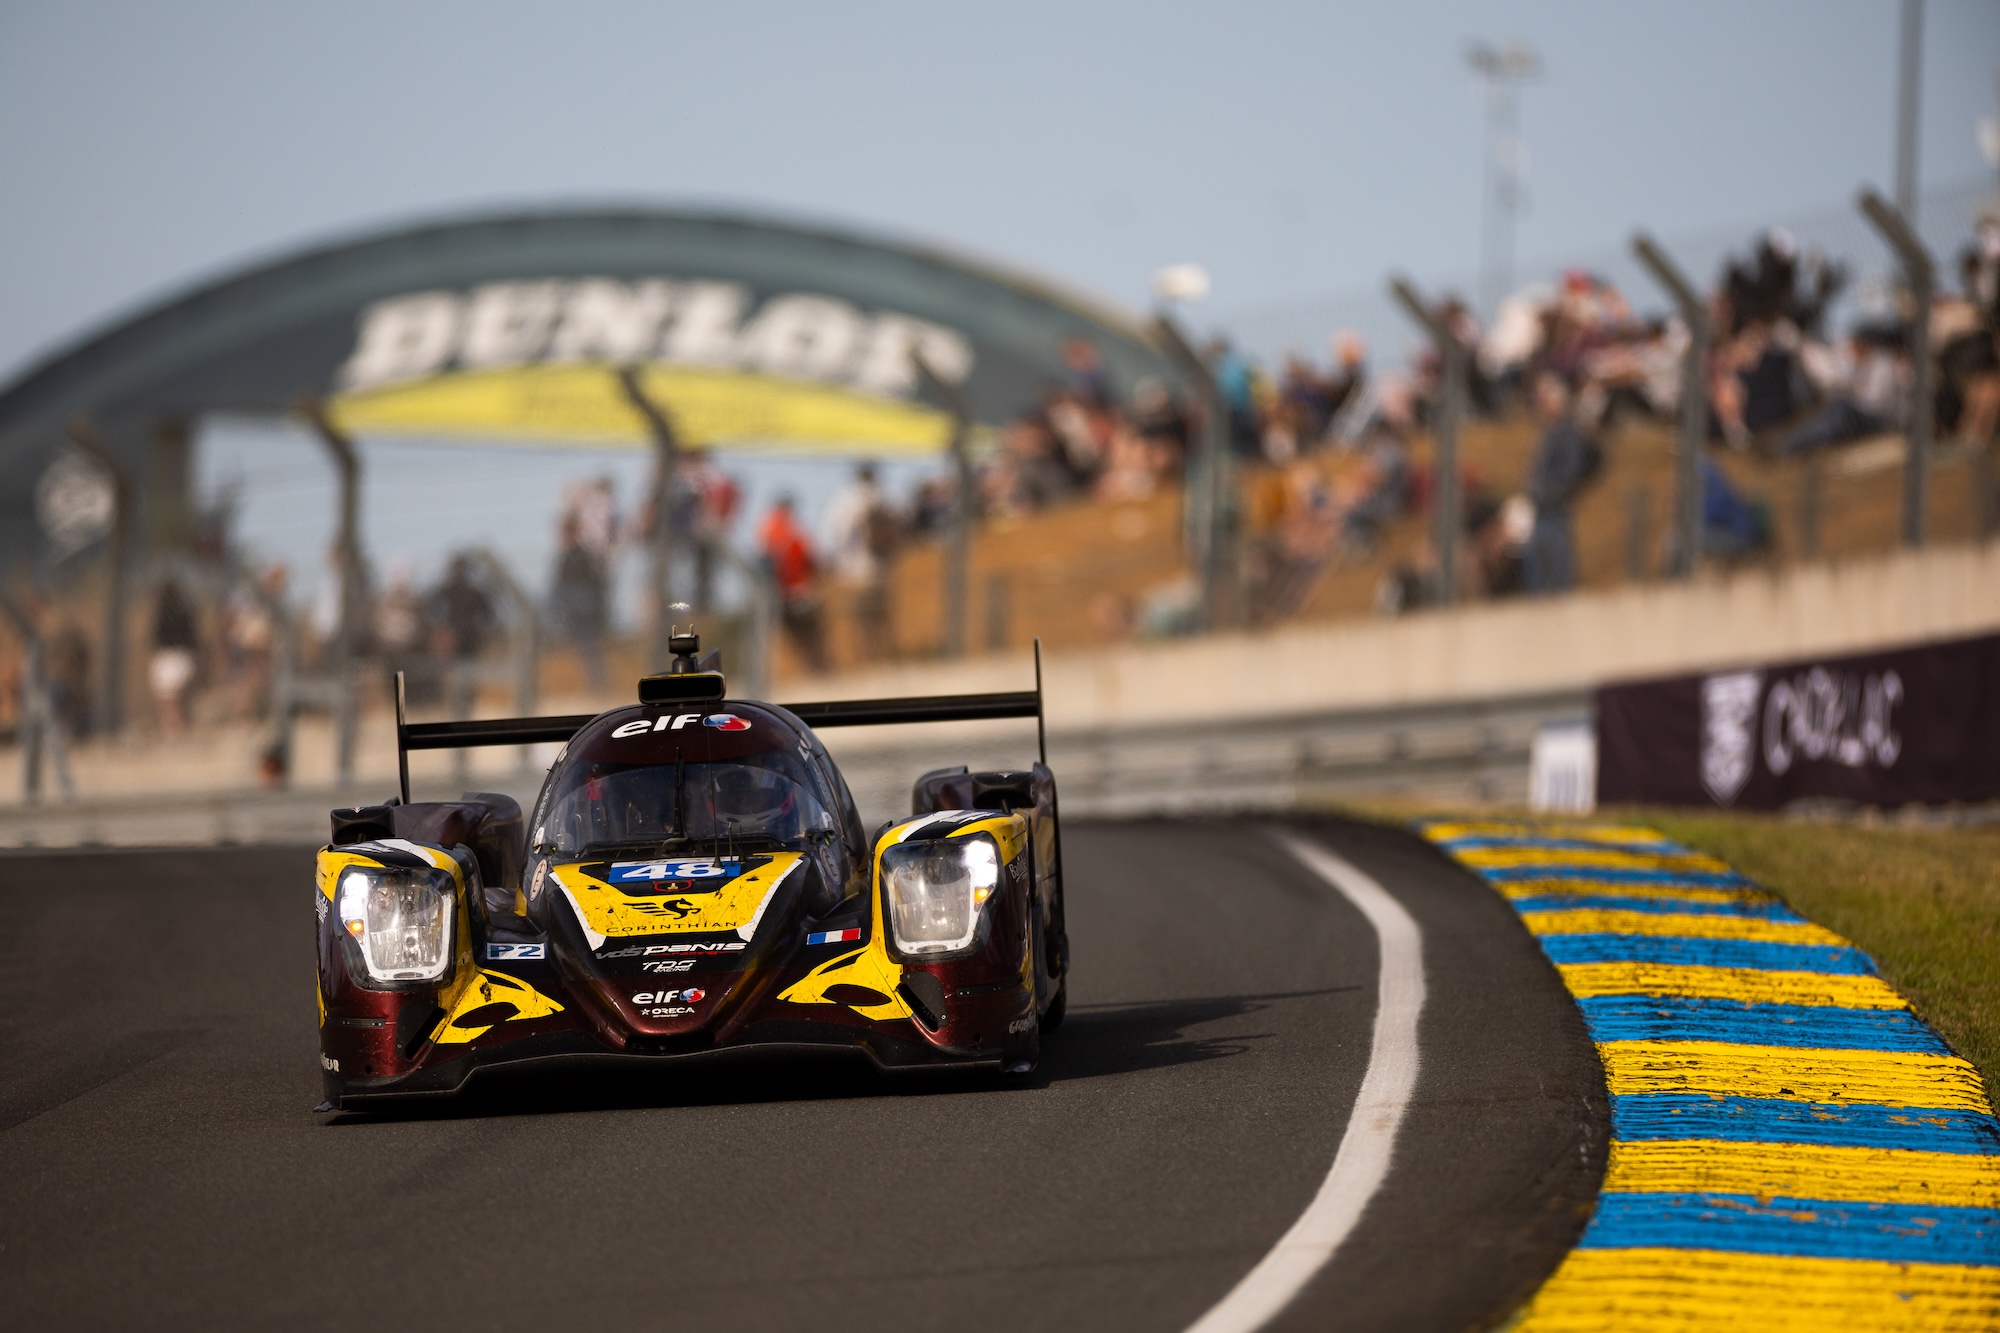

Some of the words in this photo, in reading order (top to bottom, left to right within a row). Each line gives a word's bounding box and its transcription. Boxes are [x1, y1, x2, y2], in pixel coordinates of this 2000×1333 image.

[341, 278, 972, 397] DUNLOP
[611, 713, 702, 739] elf
[621, 861, 726, 880] 48
[606, 921, 737, 933] CORINTHIAN
[490, 945, 541, 958] P2
[631, 989, 680, 1004] elf
[651, 1007, 696, 1015] ORECA
